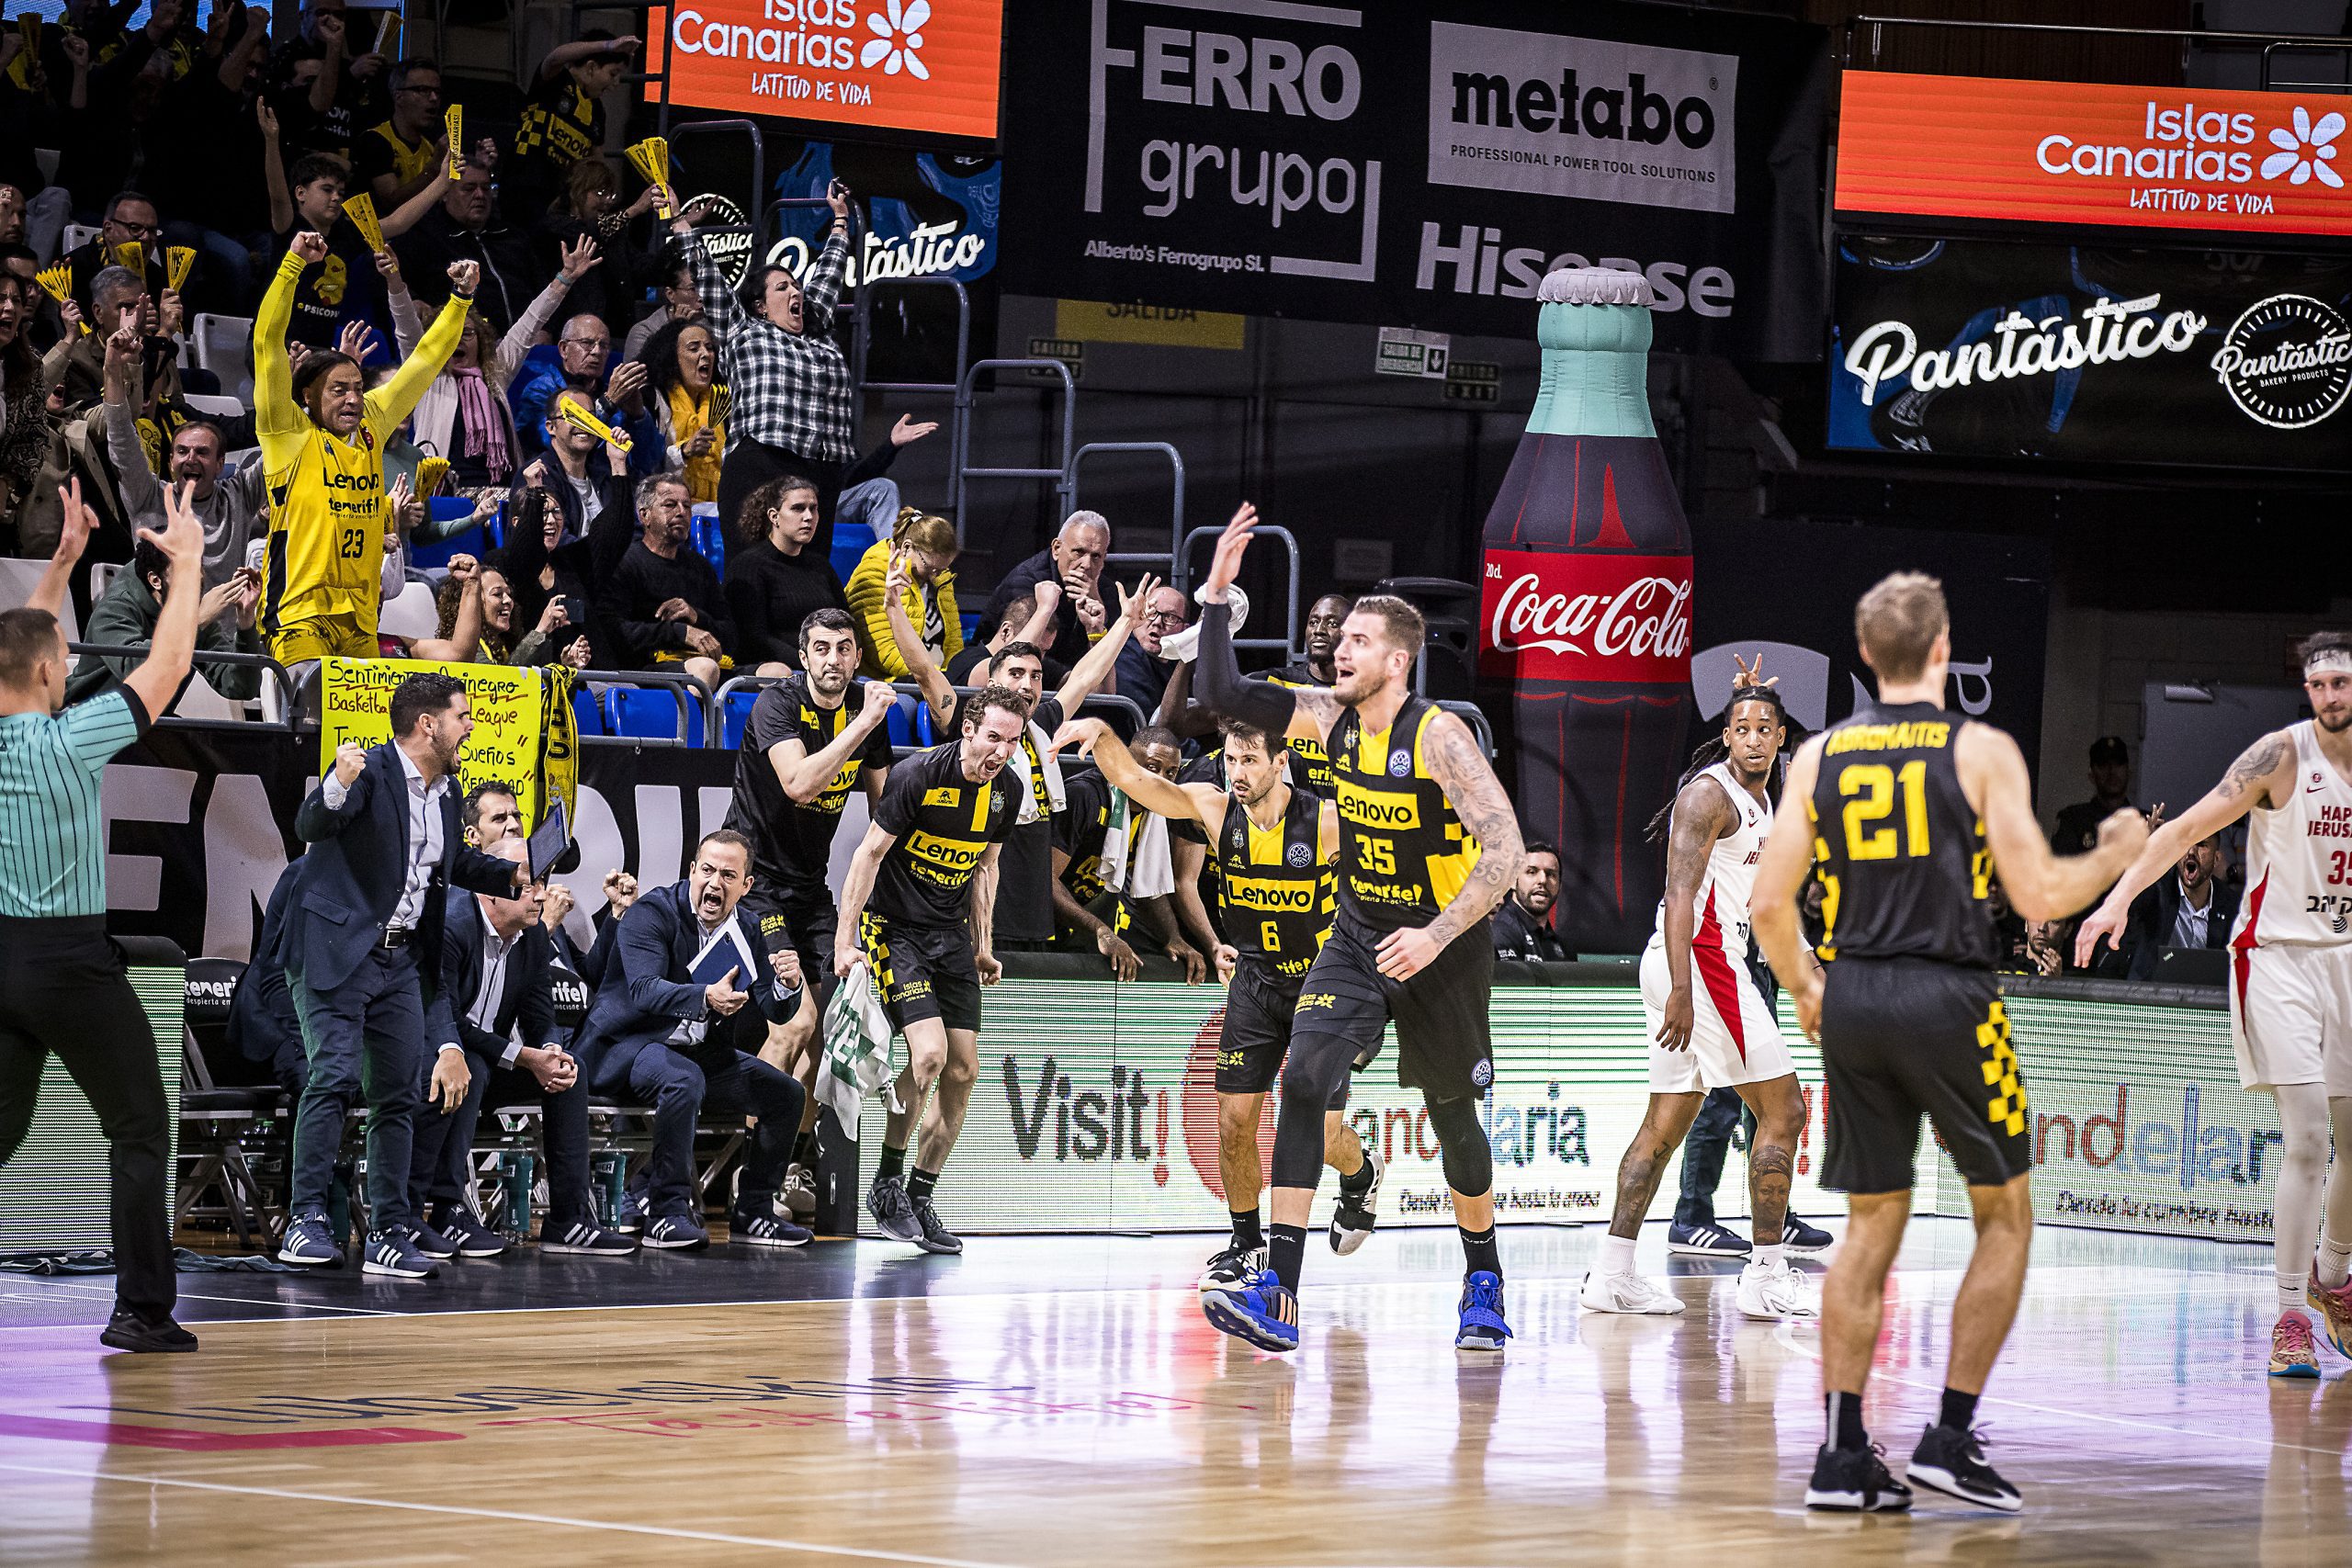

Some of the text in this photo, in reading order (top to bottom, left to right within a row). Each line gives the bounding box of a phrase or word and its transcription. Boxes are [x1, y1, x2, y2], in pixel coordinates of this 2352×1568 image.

[672, 9, 856, 71] Canarias
[751, 72, 873, 107] LATITUD DE VIDA
[1452, 68, 1715, 150] metabo
[2145, 101, 2256, 144] Islas
[1450, 143, 1716, 184] PROFESSIONAL POWER TOOL SOLUTIONS
[2036, 134, 2254, 184] Canarias
[1140, 140, 1357, 229] grupo
[2130, 187, 2275, 215] LATITUD DE VIDA
[1084, 240, 1157, 263] Alberto's
[1157, 245, 1243, 274] Ferrogrupo
[1415, 221, 1736, 319] Hisse
[1844, 292, 2208, 407] Pantástico
[2211, 332, 2352, 384] Pantástic
[2258, 368, 2330, 388] BAKERY PRODUCTS
[341, 528, 366, 558] 23
[1486, 562, 1494, 578] 20
[1491, 573, 1692, 659] Coca-Cola
[469, 697, 518, 738] League
[1838, 761, 1930, 861] 21
[2307, 820, 2352, 838] JERUS
[911, 834, 981, 865] Lenov
[1354, 833, 1396, 875] 35
[1227, 879, 1312, 908] Lenovo
[1261, 920, 1282, 952] 6
[186, 997, 220, 1006] despierta
[891, 987, 924, 1002] Canarias
[903, 980, 923, 991] Islas
